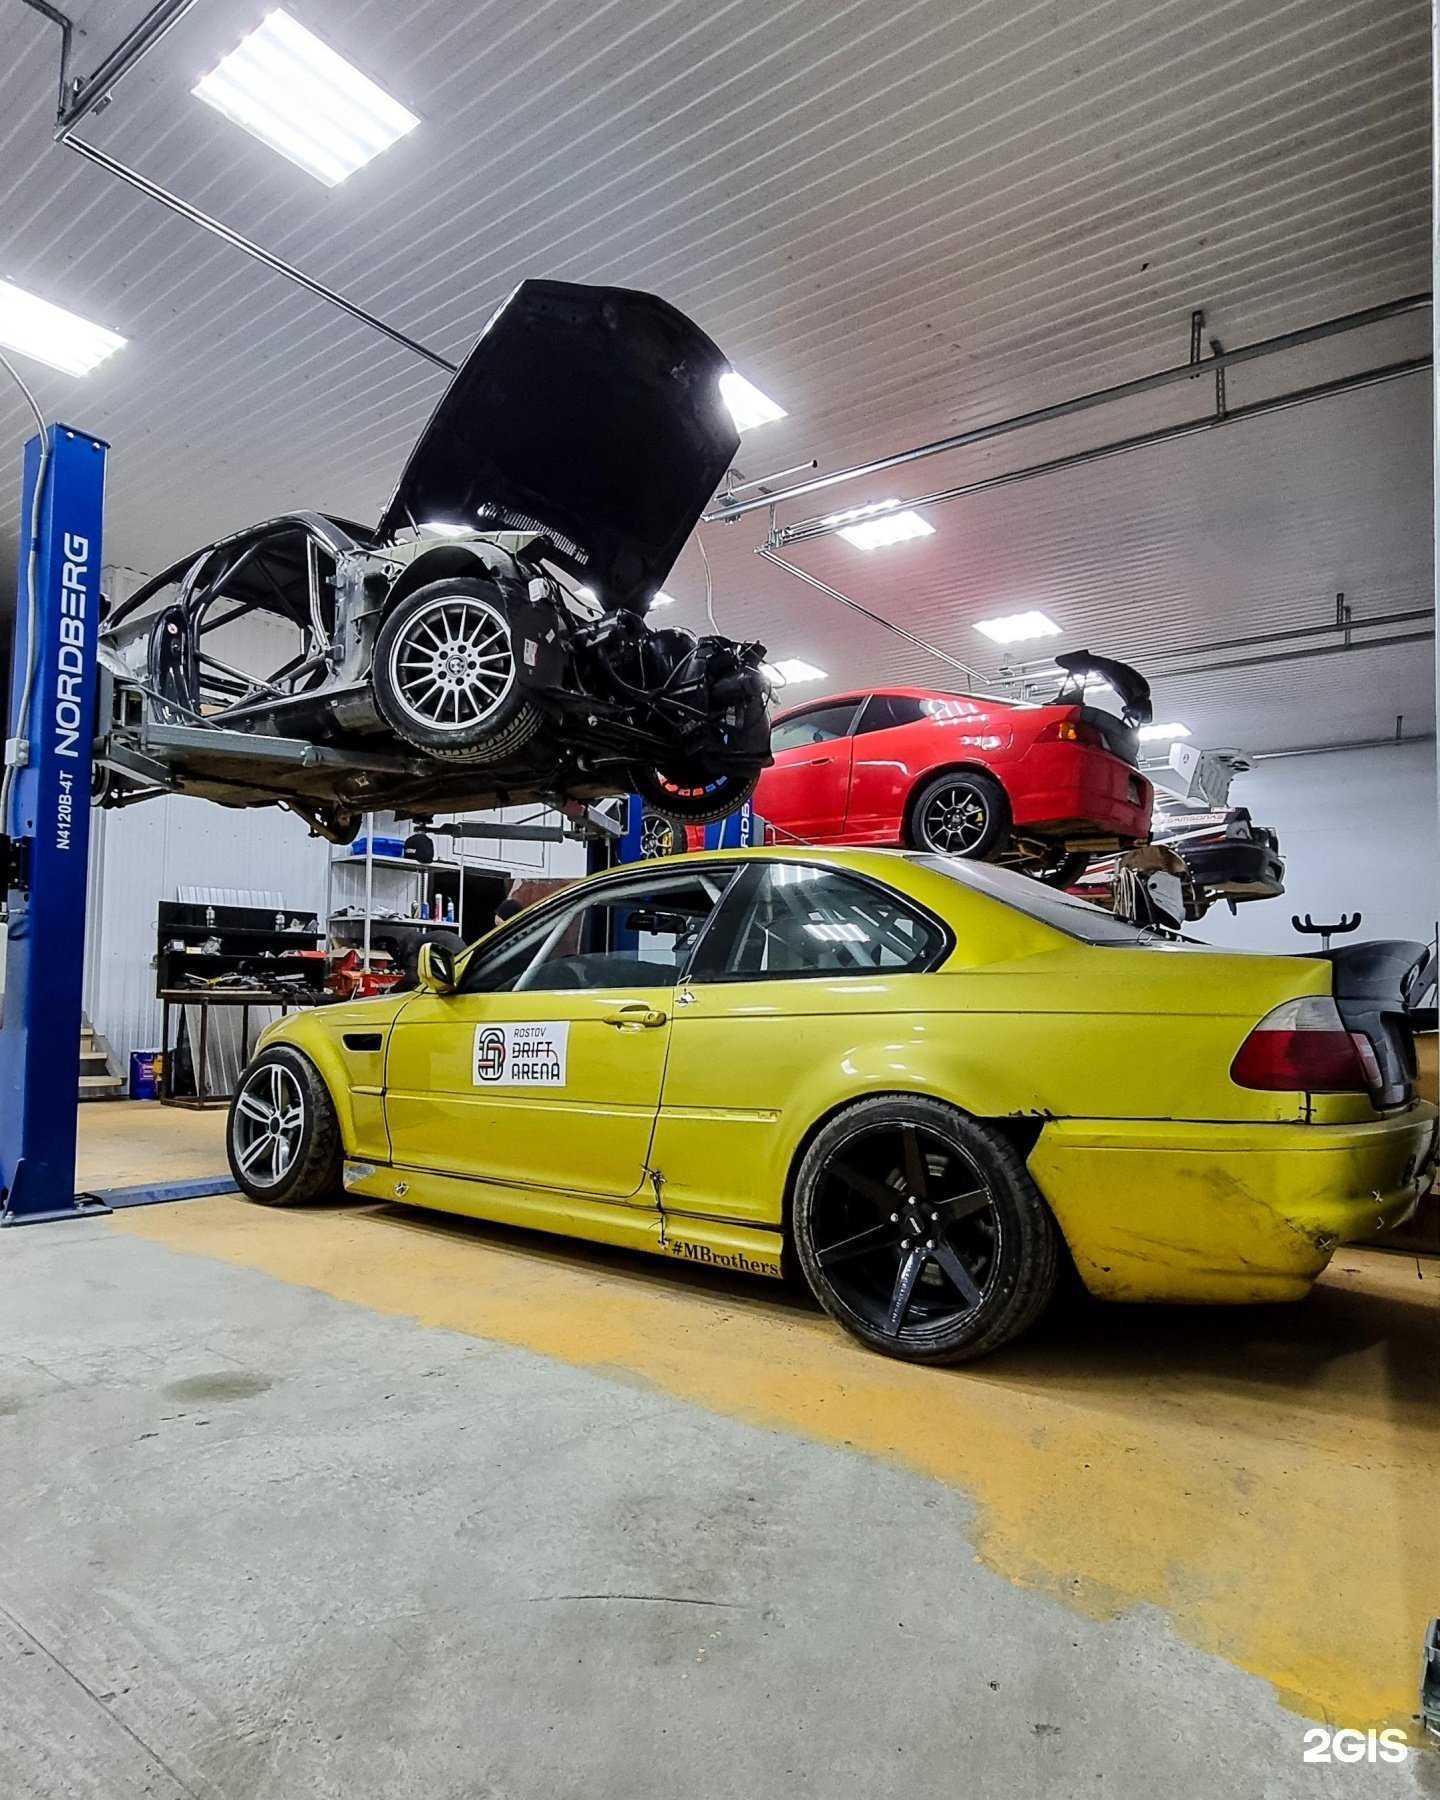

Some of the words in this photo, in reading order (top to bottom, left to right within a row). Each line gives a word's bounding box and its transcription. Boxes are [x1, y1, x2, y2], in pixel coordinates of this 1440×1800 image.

[54, 533, 89, 758] NORDBERG
[56, 770, 73, 850] N4120B-4T
[513, 1028, 546, 1038] ROSTOV
[511, 1062, 560, 1080] ARENA
[672, 1241, 778, 1275] #MBrothers
